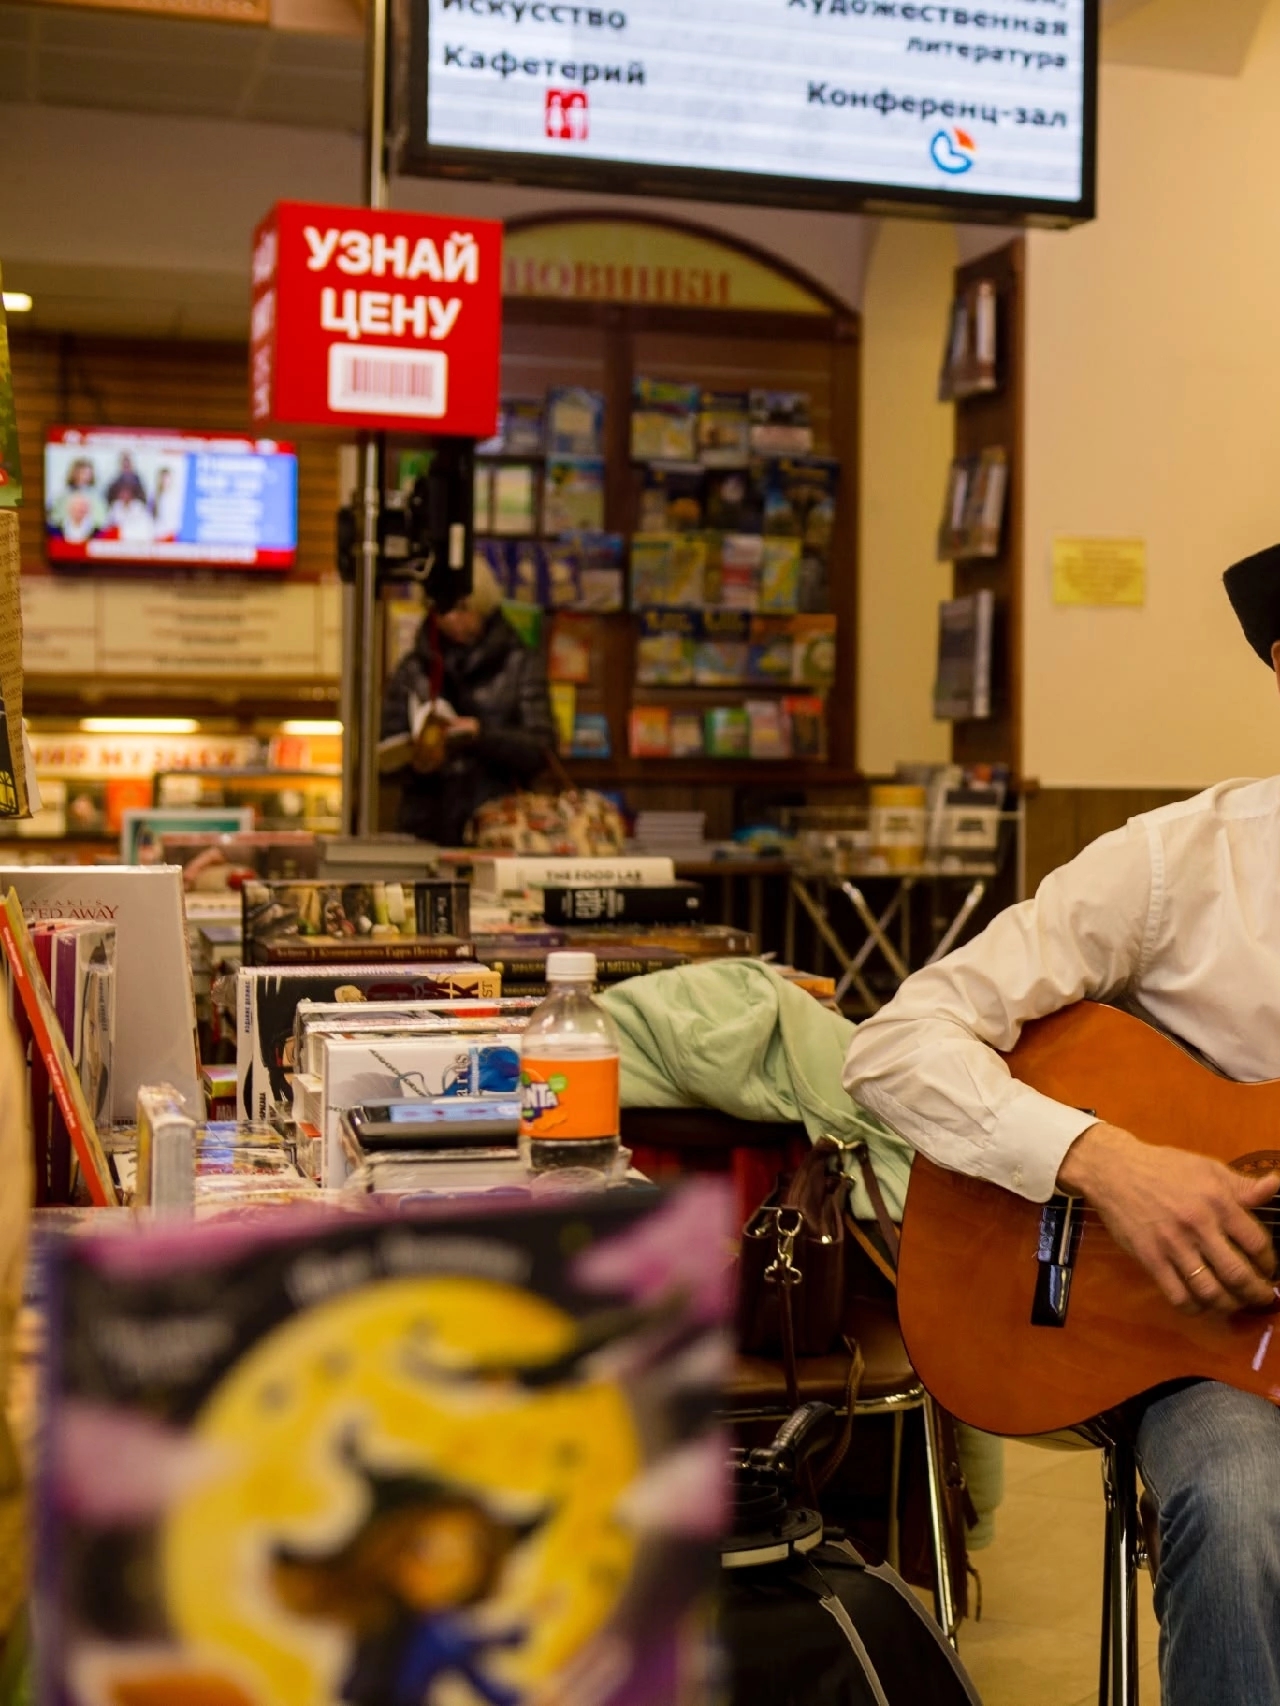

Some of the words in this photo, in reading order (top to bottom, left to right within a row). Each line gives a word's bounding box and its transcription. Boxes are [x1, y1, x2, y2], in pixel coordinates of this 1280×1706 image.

[444, 44, 645, 85] Кафетерий
[907, 37, 1067, 68] литература
[808, 80, 1067, 127] Конференц-зал
[303, 226, 479, 283] УЗНАЙ
[320, 287, 462, 340] ЦЕНУ
[69, 905, 119, 919] AWAY
